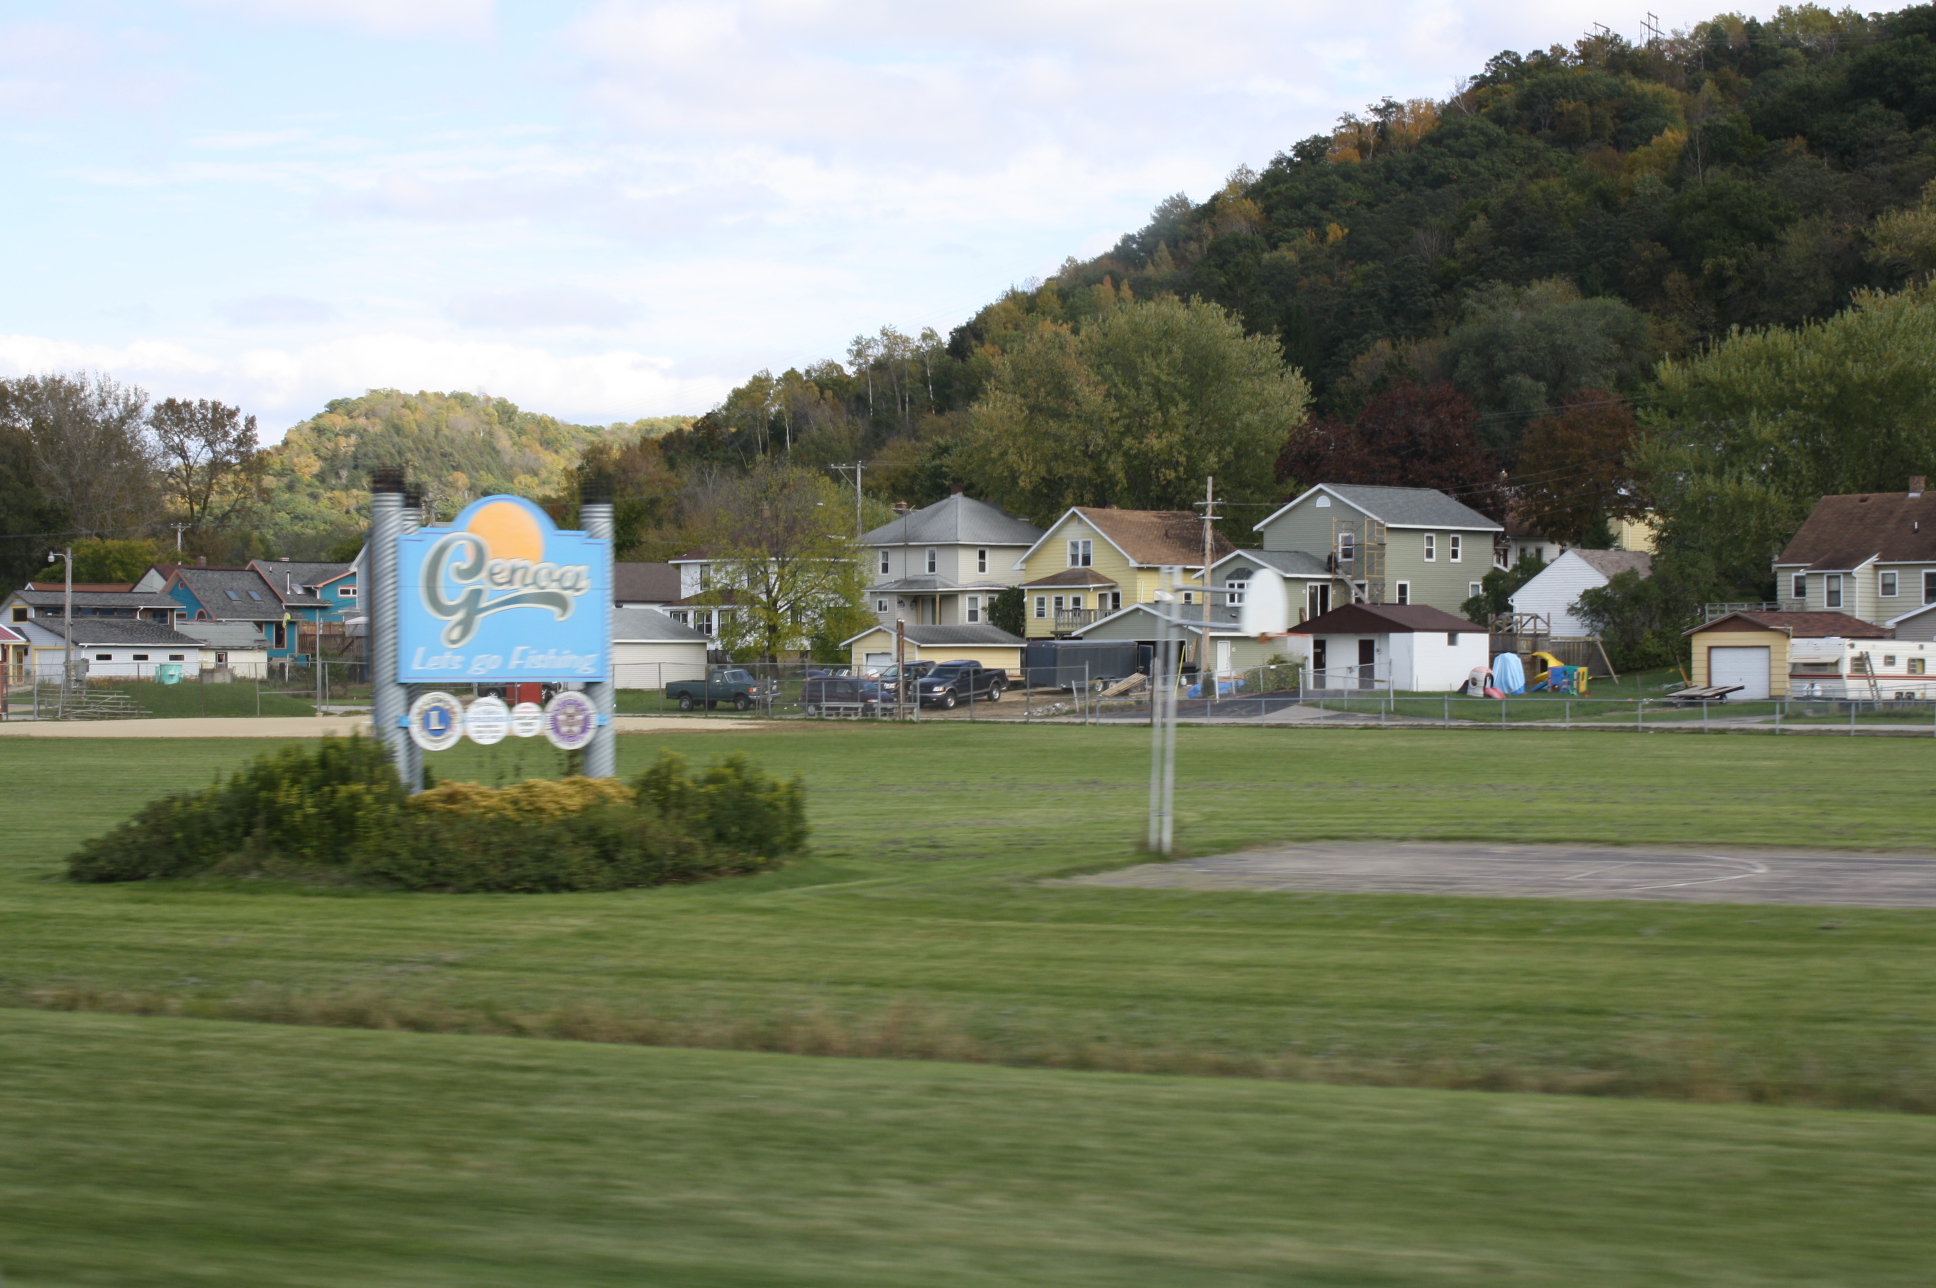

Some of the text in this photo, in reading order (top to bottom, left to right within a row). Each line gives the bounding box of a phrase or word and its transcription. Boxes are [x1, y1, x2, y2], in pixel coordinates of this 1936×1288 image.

[419, 531, 591, 649] Genoa
[466, 653, 503, 675] go
[508, 646, 600, 675] Fishing
[427, 710, 446, 731] L
